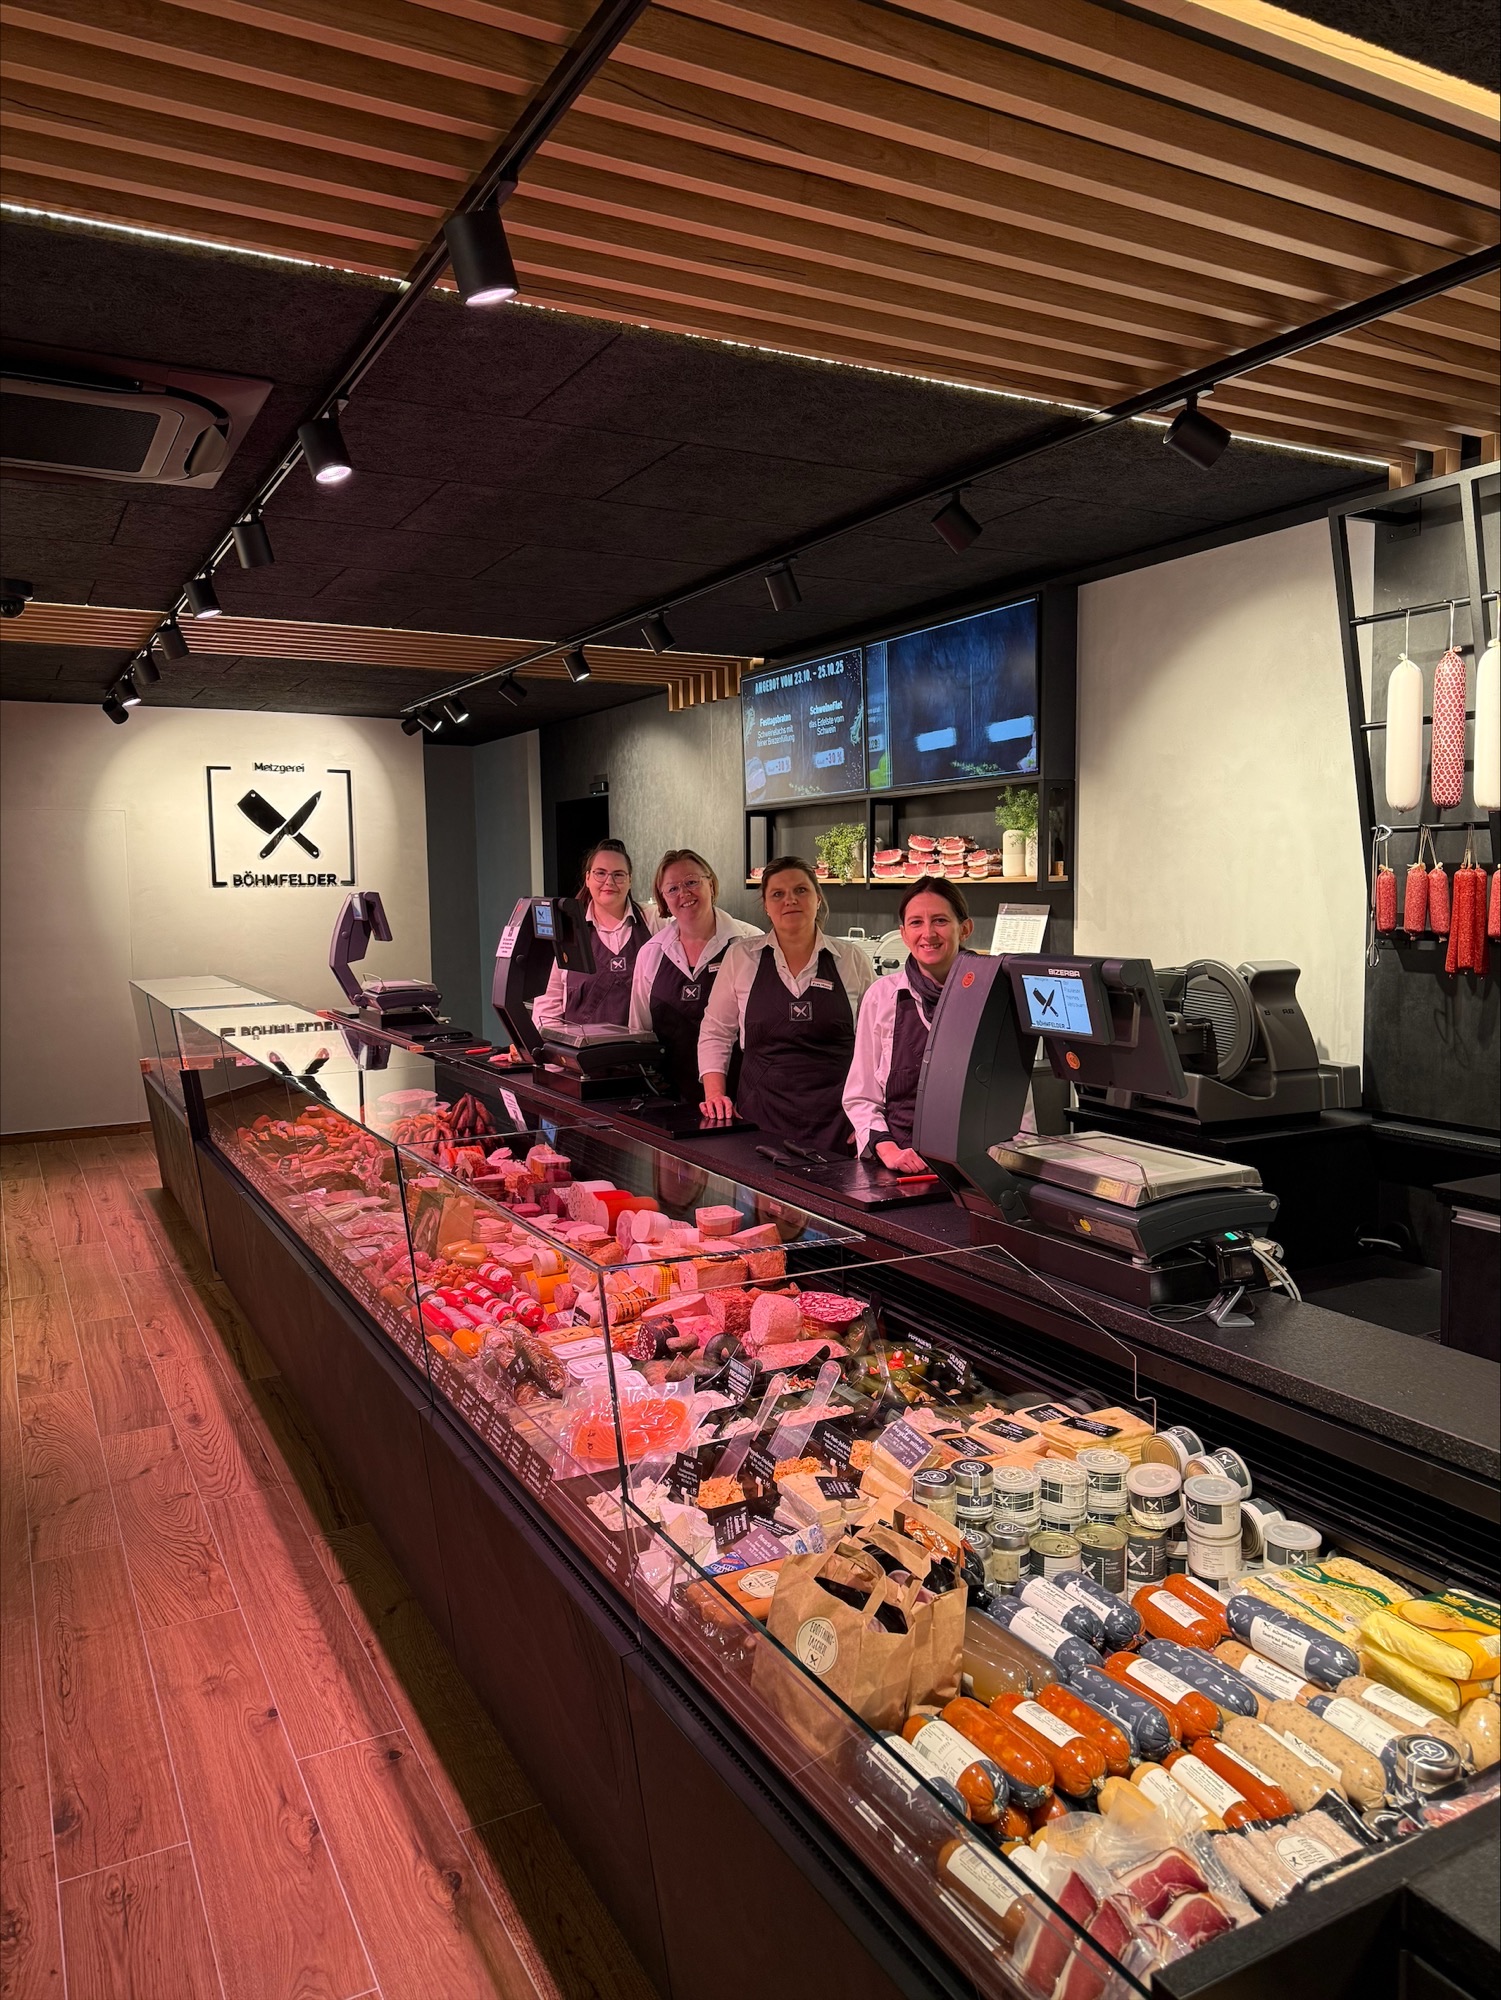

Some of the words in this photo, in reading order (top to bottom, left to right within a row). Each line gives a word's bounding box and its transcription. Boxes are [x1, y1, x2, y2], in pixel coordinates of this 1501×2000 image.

[755, 677, 780, 694] ANGEBOT
[780, 674, 794, 689] VOM
[794, 669, 812, 686] 23.10.
[818, 660, 844, 678] 25.10.25
[254, 762, 305, 774] Metzgerei
[232, 871, 337, 887] BÖHMFELDER
[1048, 968, 1080, 978] BIZERBA
[950, 1354, 966, 1371] OLIVEN
